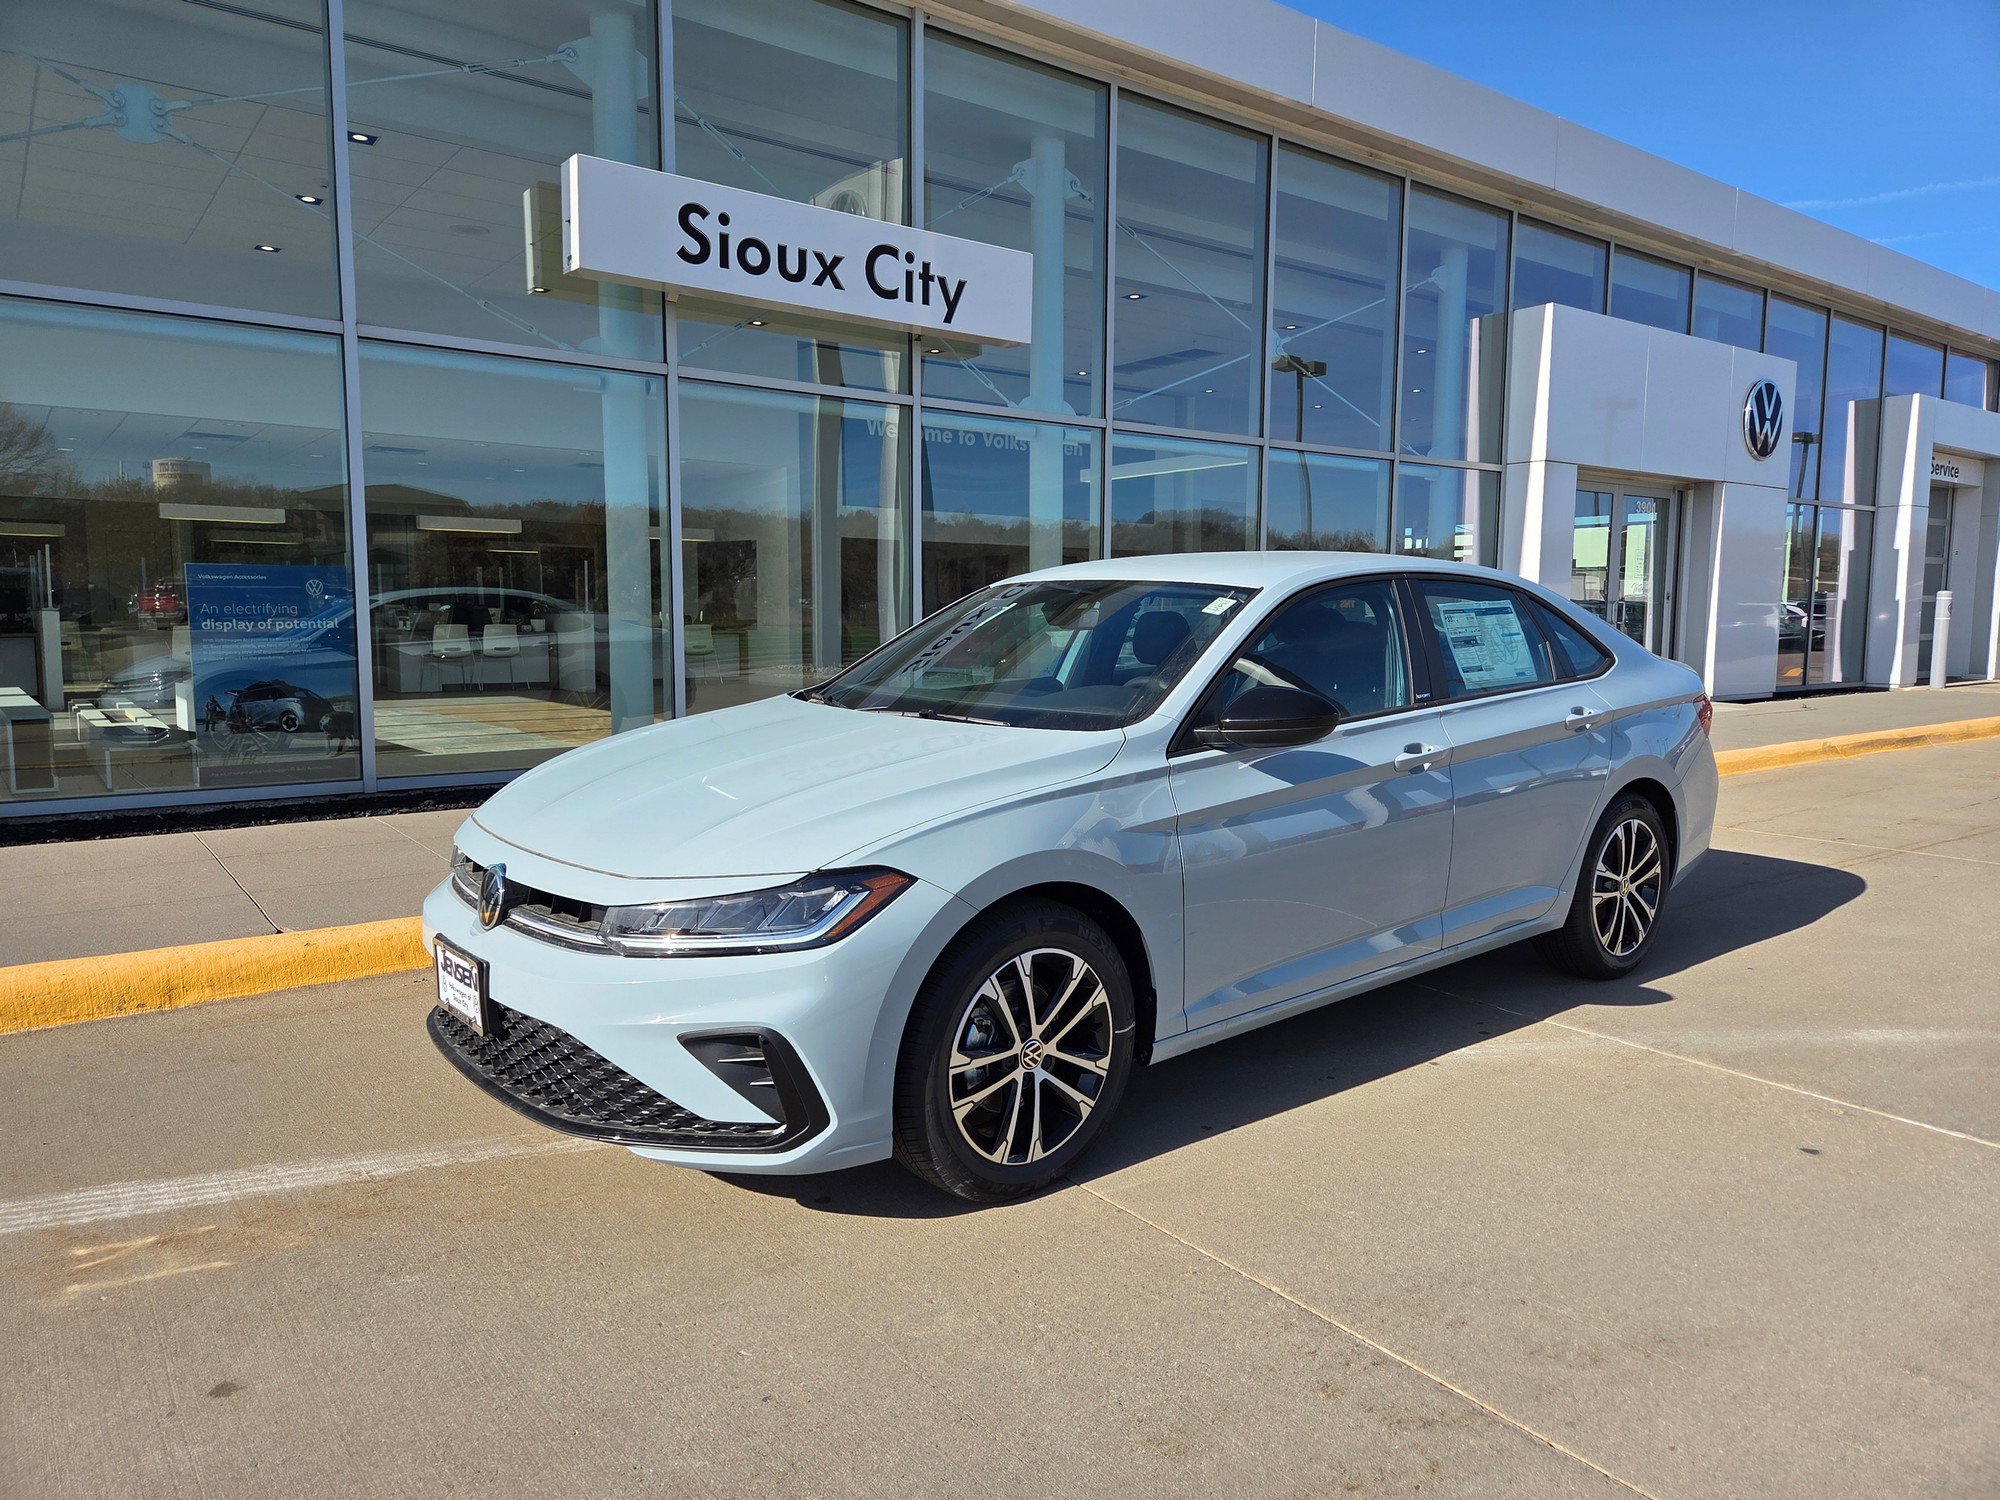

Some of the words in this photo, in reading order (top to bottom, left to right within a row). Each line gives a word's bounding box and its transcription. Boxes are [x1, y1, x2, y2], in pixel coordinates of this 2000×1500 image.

[676, 202, 845, 291] Sioux
[865, 243, 967, 324] City
[958, 430, 976, 446] to
[201, 603, 219, 614] An
[224, 602, 298, 616] electrifying
[201, 618, 254, 632] display
[257, 618, 273, 630] of
[275, 617, 340, 631] potential
[440, 951, 478, 992] JENSEN
